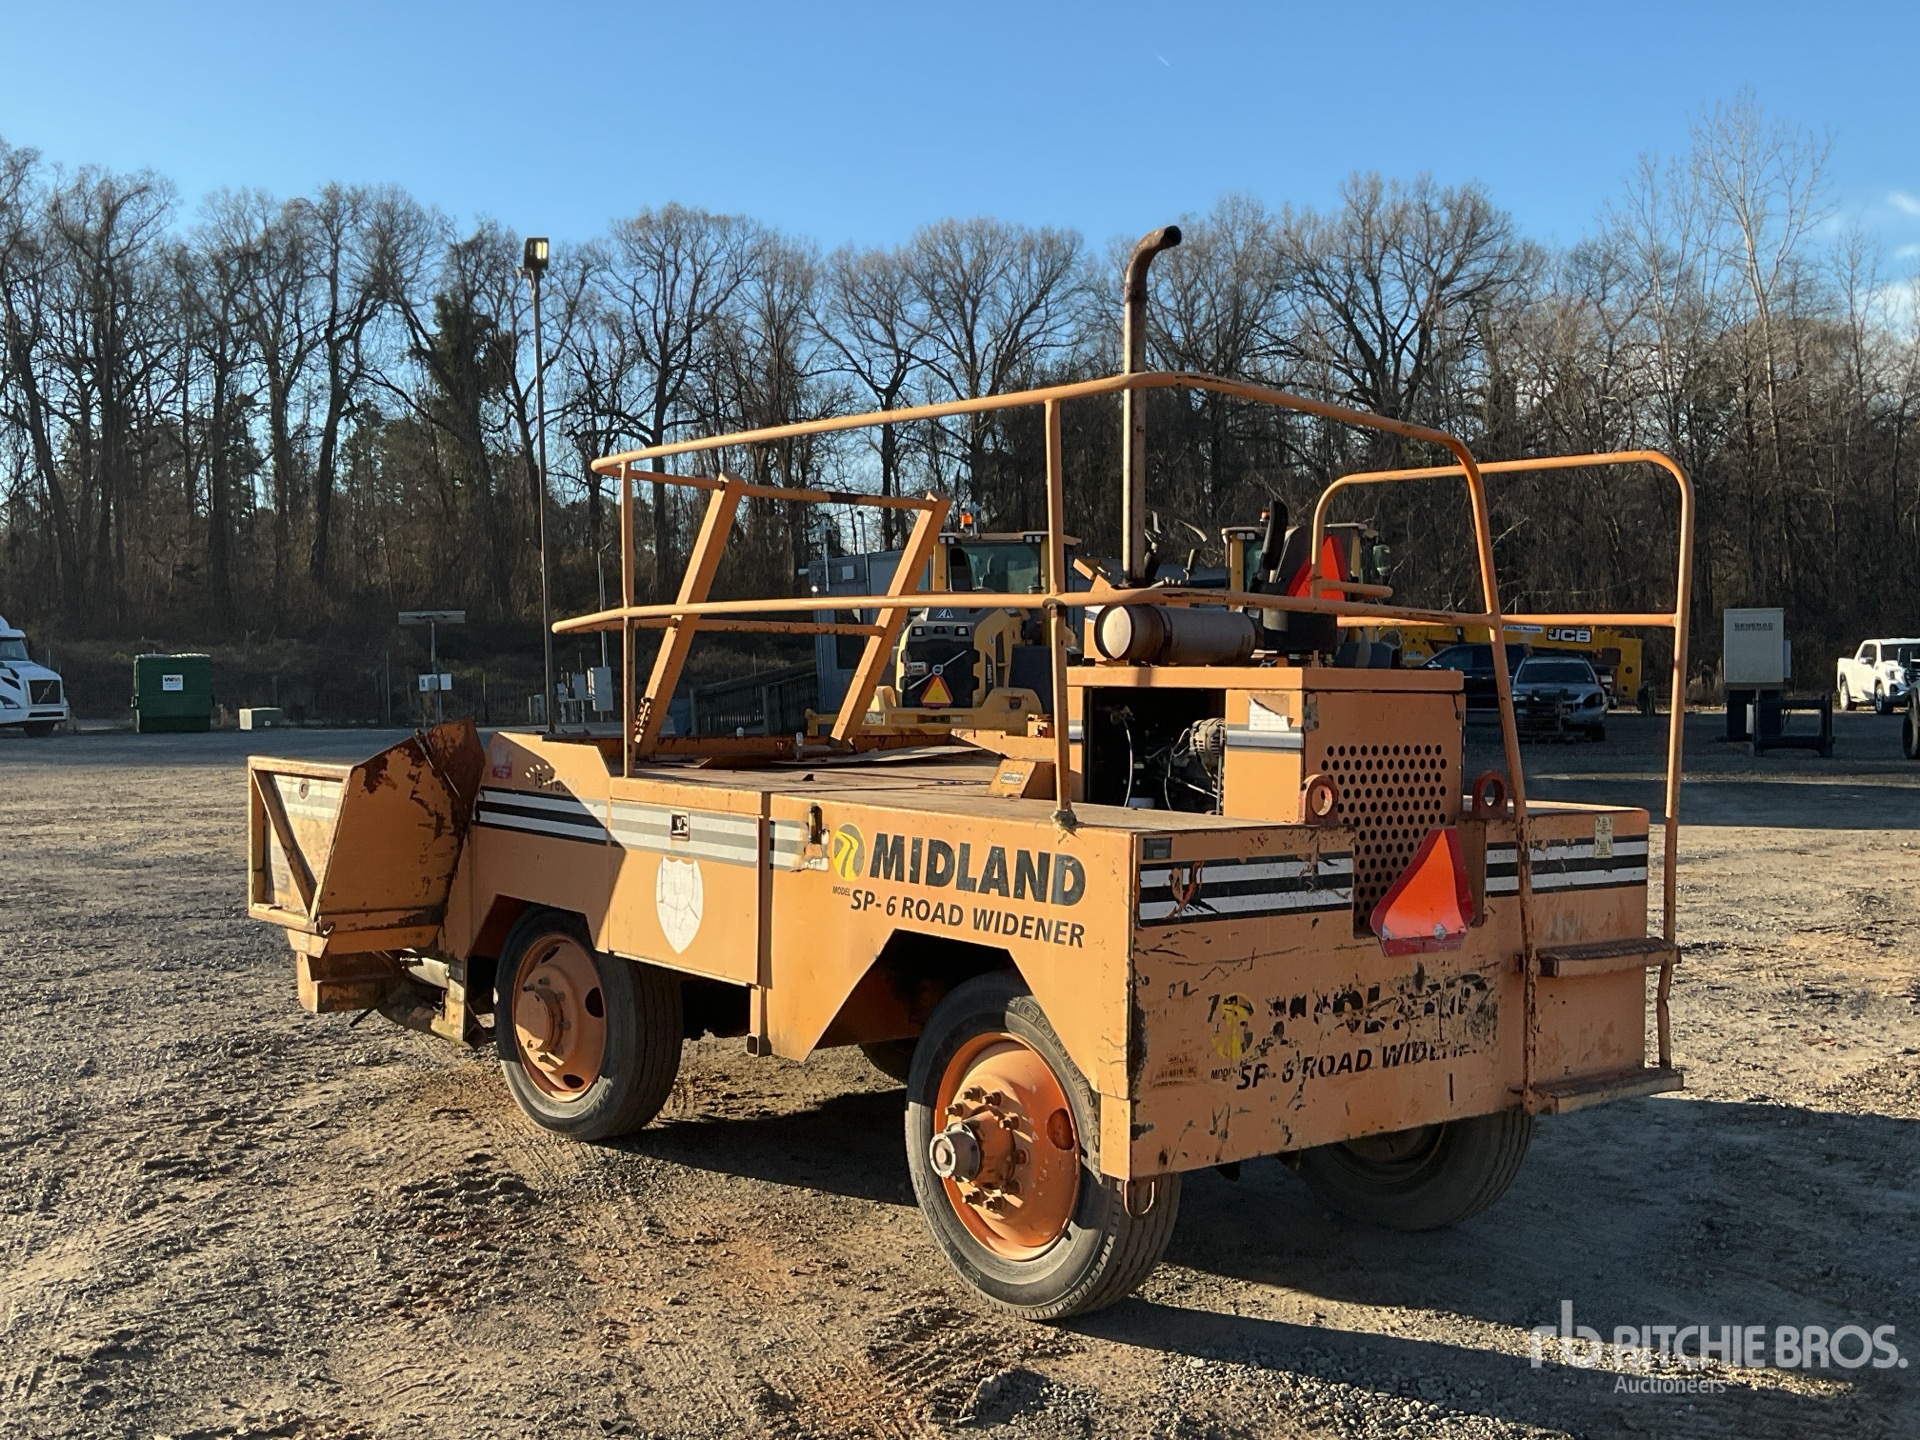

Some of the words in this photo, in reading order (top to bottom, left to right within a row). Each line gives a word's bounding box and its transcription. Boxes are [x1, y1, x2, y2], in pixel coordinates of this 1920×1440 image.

[1548, 628, 1591, 643] JCB
[869, 833, 1086, 906] MIDLAND
[832, 886, 851, 897] MODEL
[901, 897, 963, 926] ROAD
[973, 908, 1085, 948] WIDENER
[1302, 1049, 1372, 1079] ROAD
